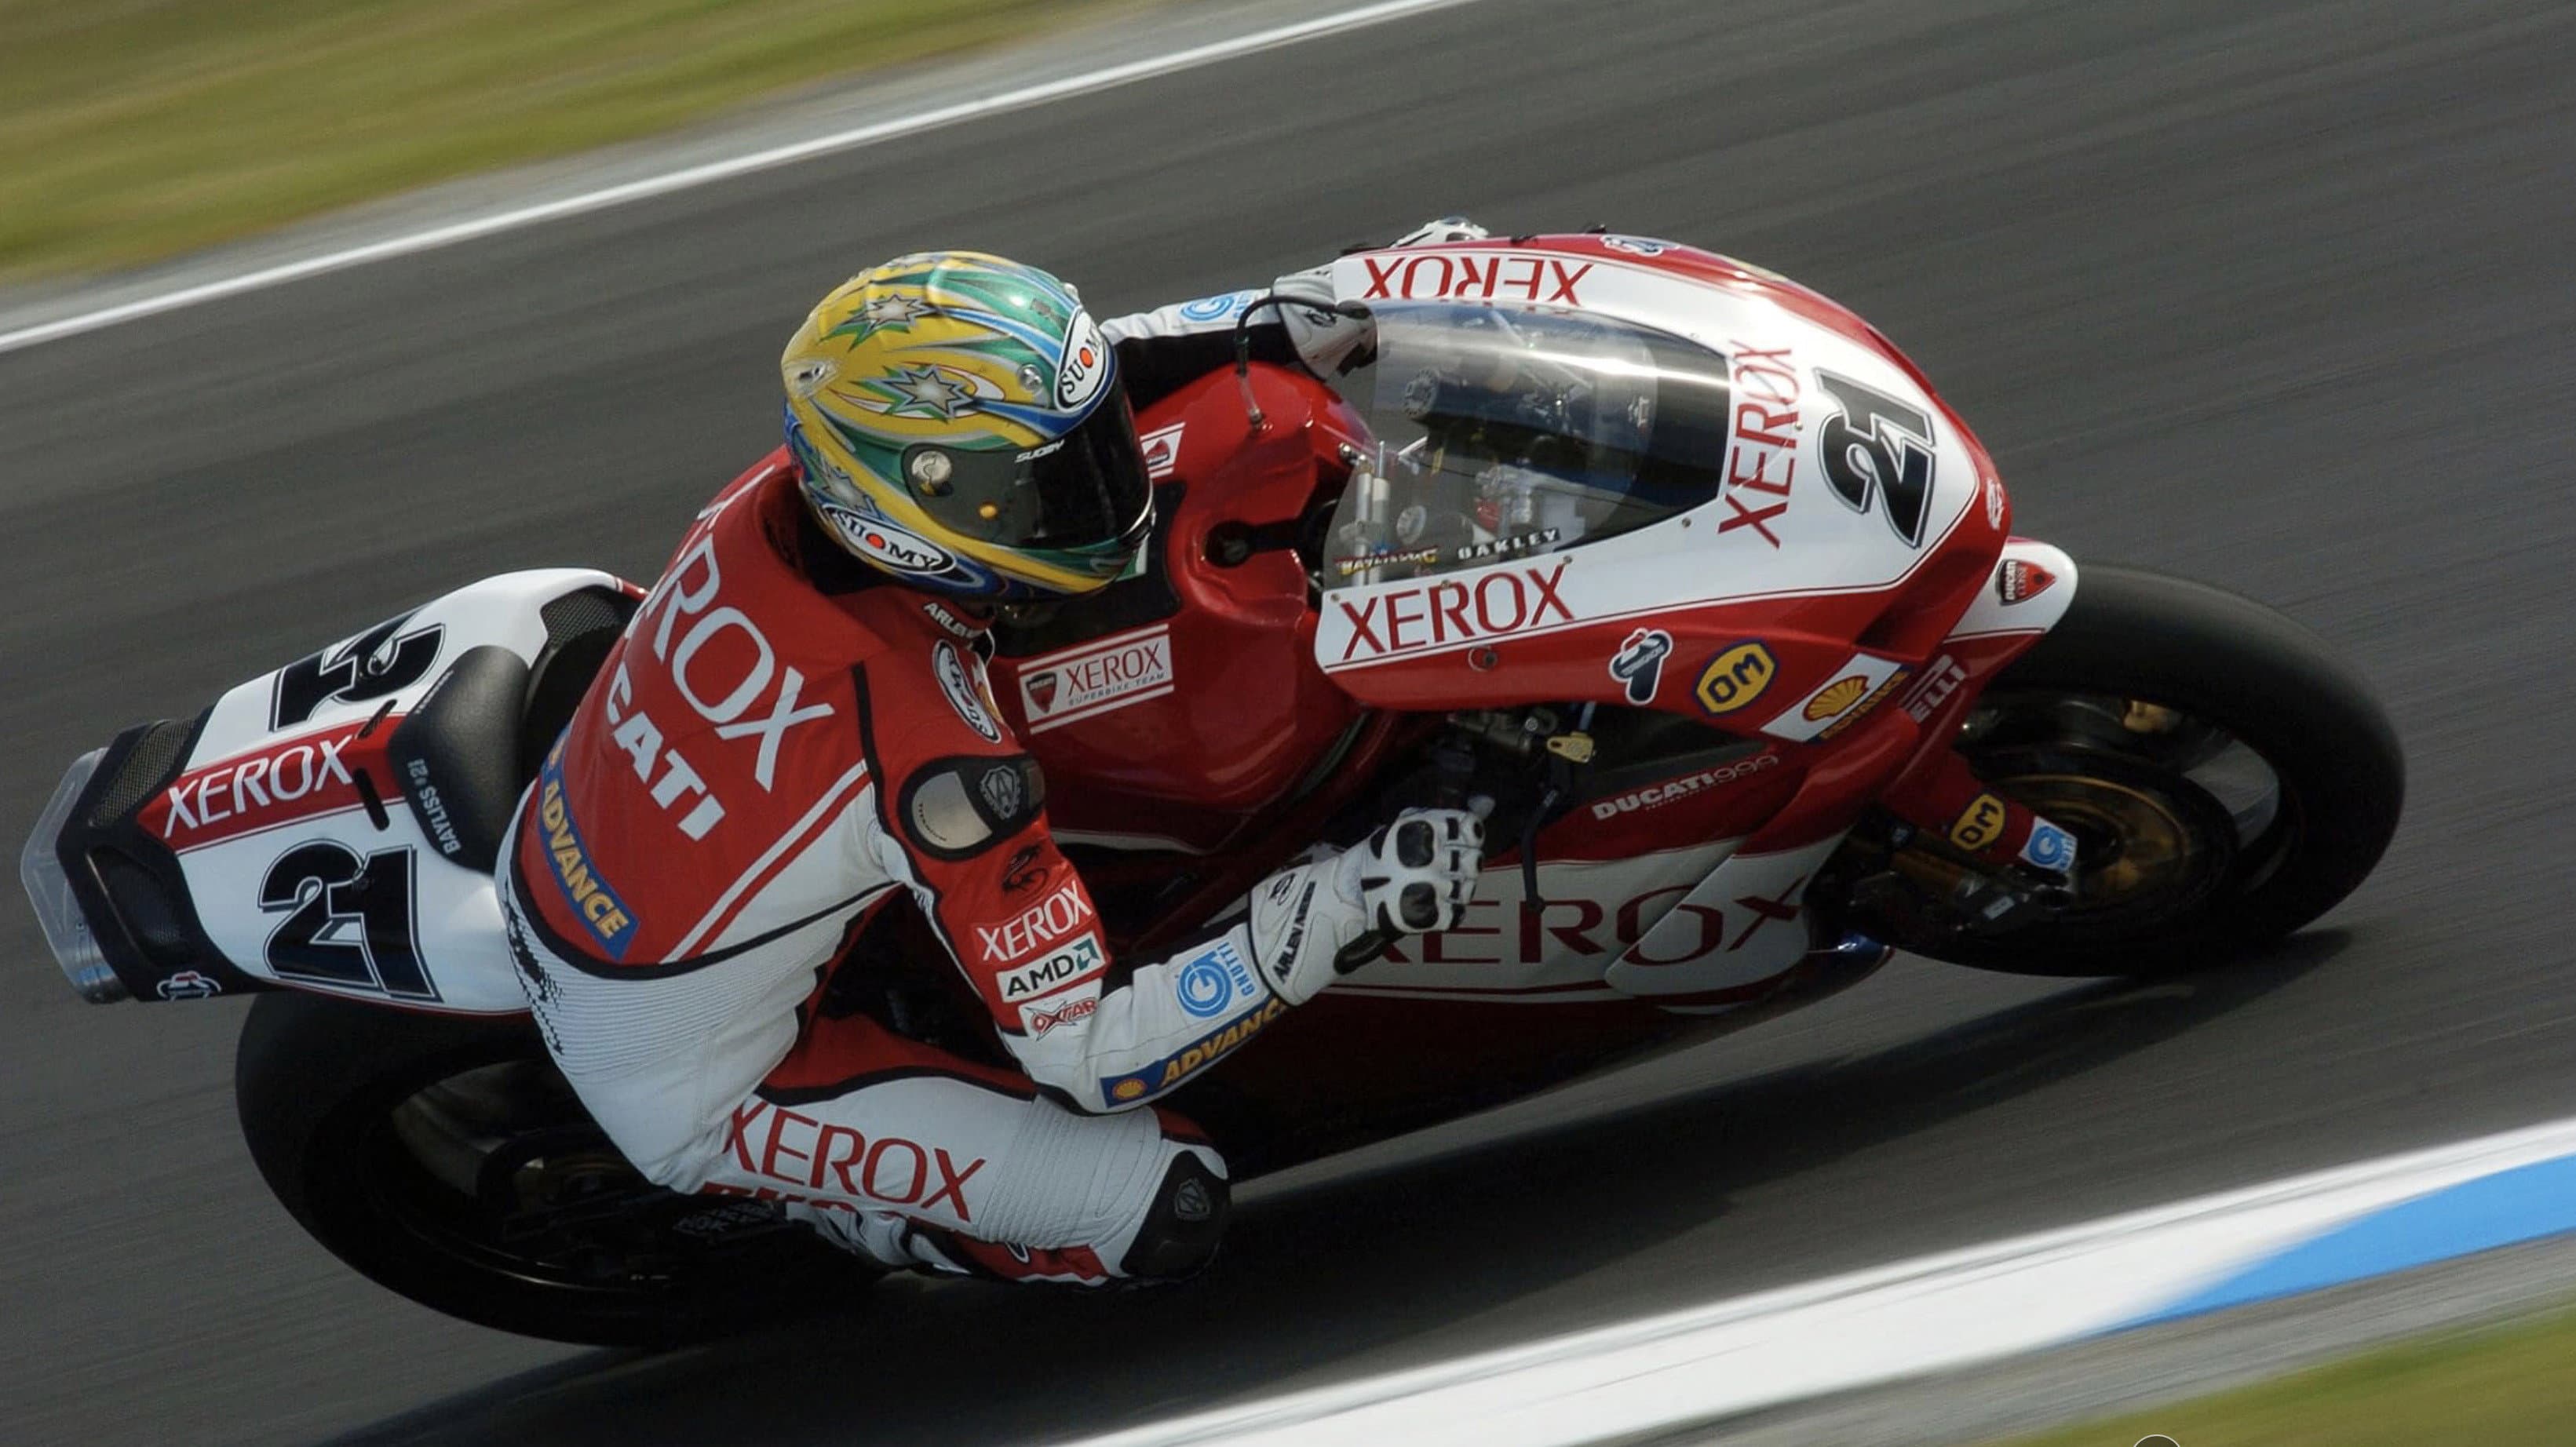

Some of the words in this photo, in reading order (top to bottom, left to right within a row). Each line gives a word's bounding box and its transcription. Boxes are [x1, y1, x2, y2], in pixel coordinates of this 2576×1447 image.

[1363, 256, 1593, 307] XEROX
[1718, 340, 1801, 550] XEROX
[1813, 367, 1936, 549] 21
[1457, 528, 1562, 561] OAKLEY
[1339, 563, 1574, 660] XEROX
[1066, 643, 1164, 697] XEROX
[1069, 684, 1130, 706] SUPERBIKE
[1135, 672, 1166, 687] TEAM
[1706, 652, 1765, 705] OM
[163, 733, 355, 840] XEROX
[604, 659, 726, 842] CATI
[419, 785, 462, 855] BAYLISS
[542, 778, 629, 940] ADVANCE
[259, 840, 444, 1004] 21
[976, 880, 1093, 962] XEROX
[1272, 927, 1305, 985] ARLEN
[1377, 875, 1807, 968] EROX
[1007, 953, 1075, 997] AMD
[1217, 942, 1256, 997] GNUTTI
[1158, 997, 1287, 1089] ADVANC
[723, 1099, 986, 1223] XEROX
